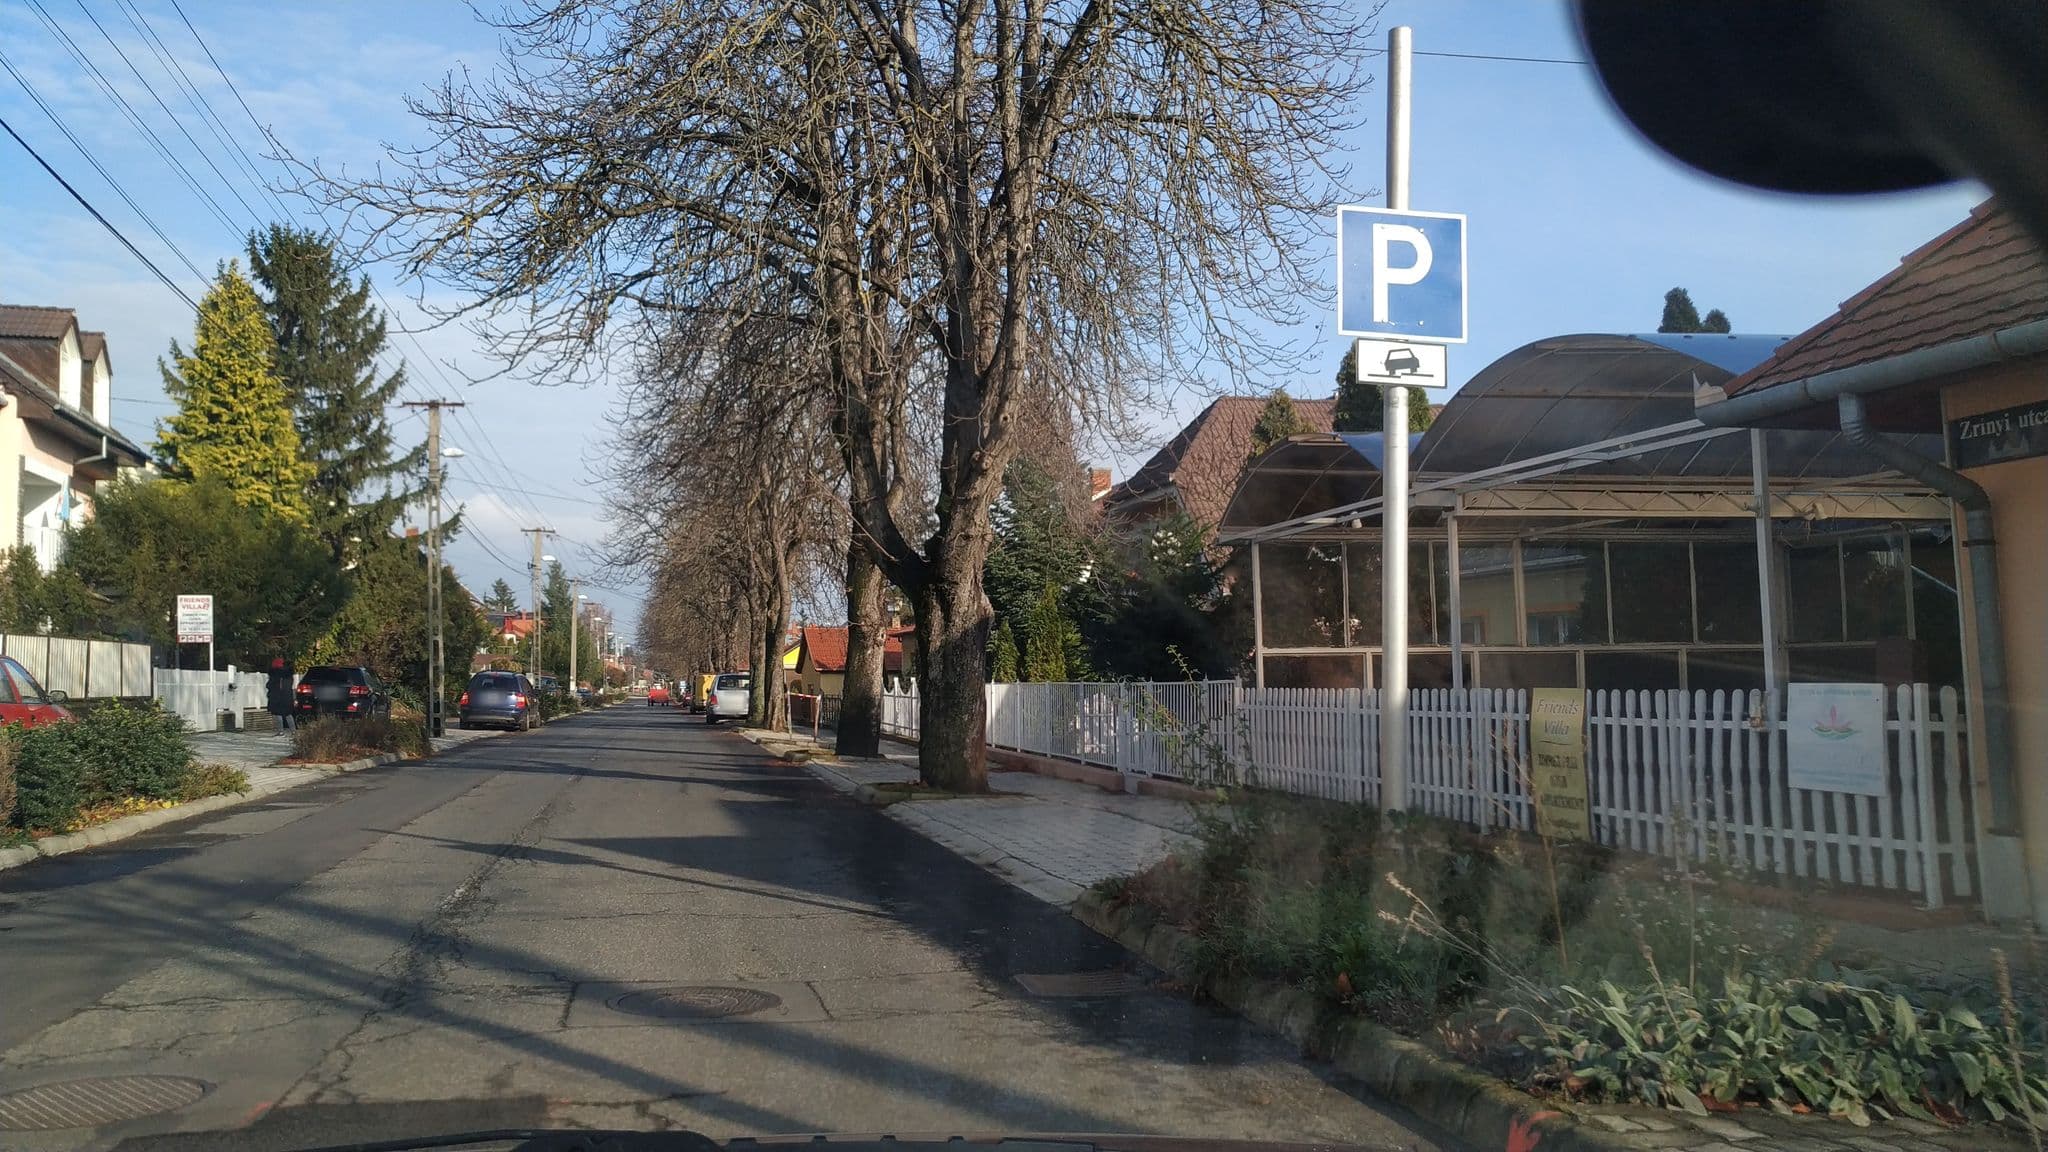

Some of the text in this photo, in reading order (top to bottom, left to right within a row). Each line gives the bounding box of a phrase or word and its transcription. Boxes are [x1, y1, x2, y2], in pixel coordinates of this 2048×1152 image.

[1372, 223, 1433, 323] P
[1536, 698, 1579, 715] Friends
[1544, 719, 1570, 735] Villa
